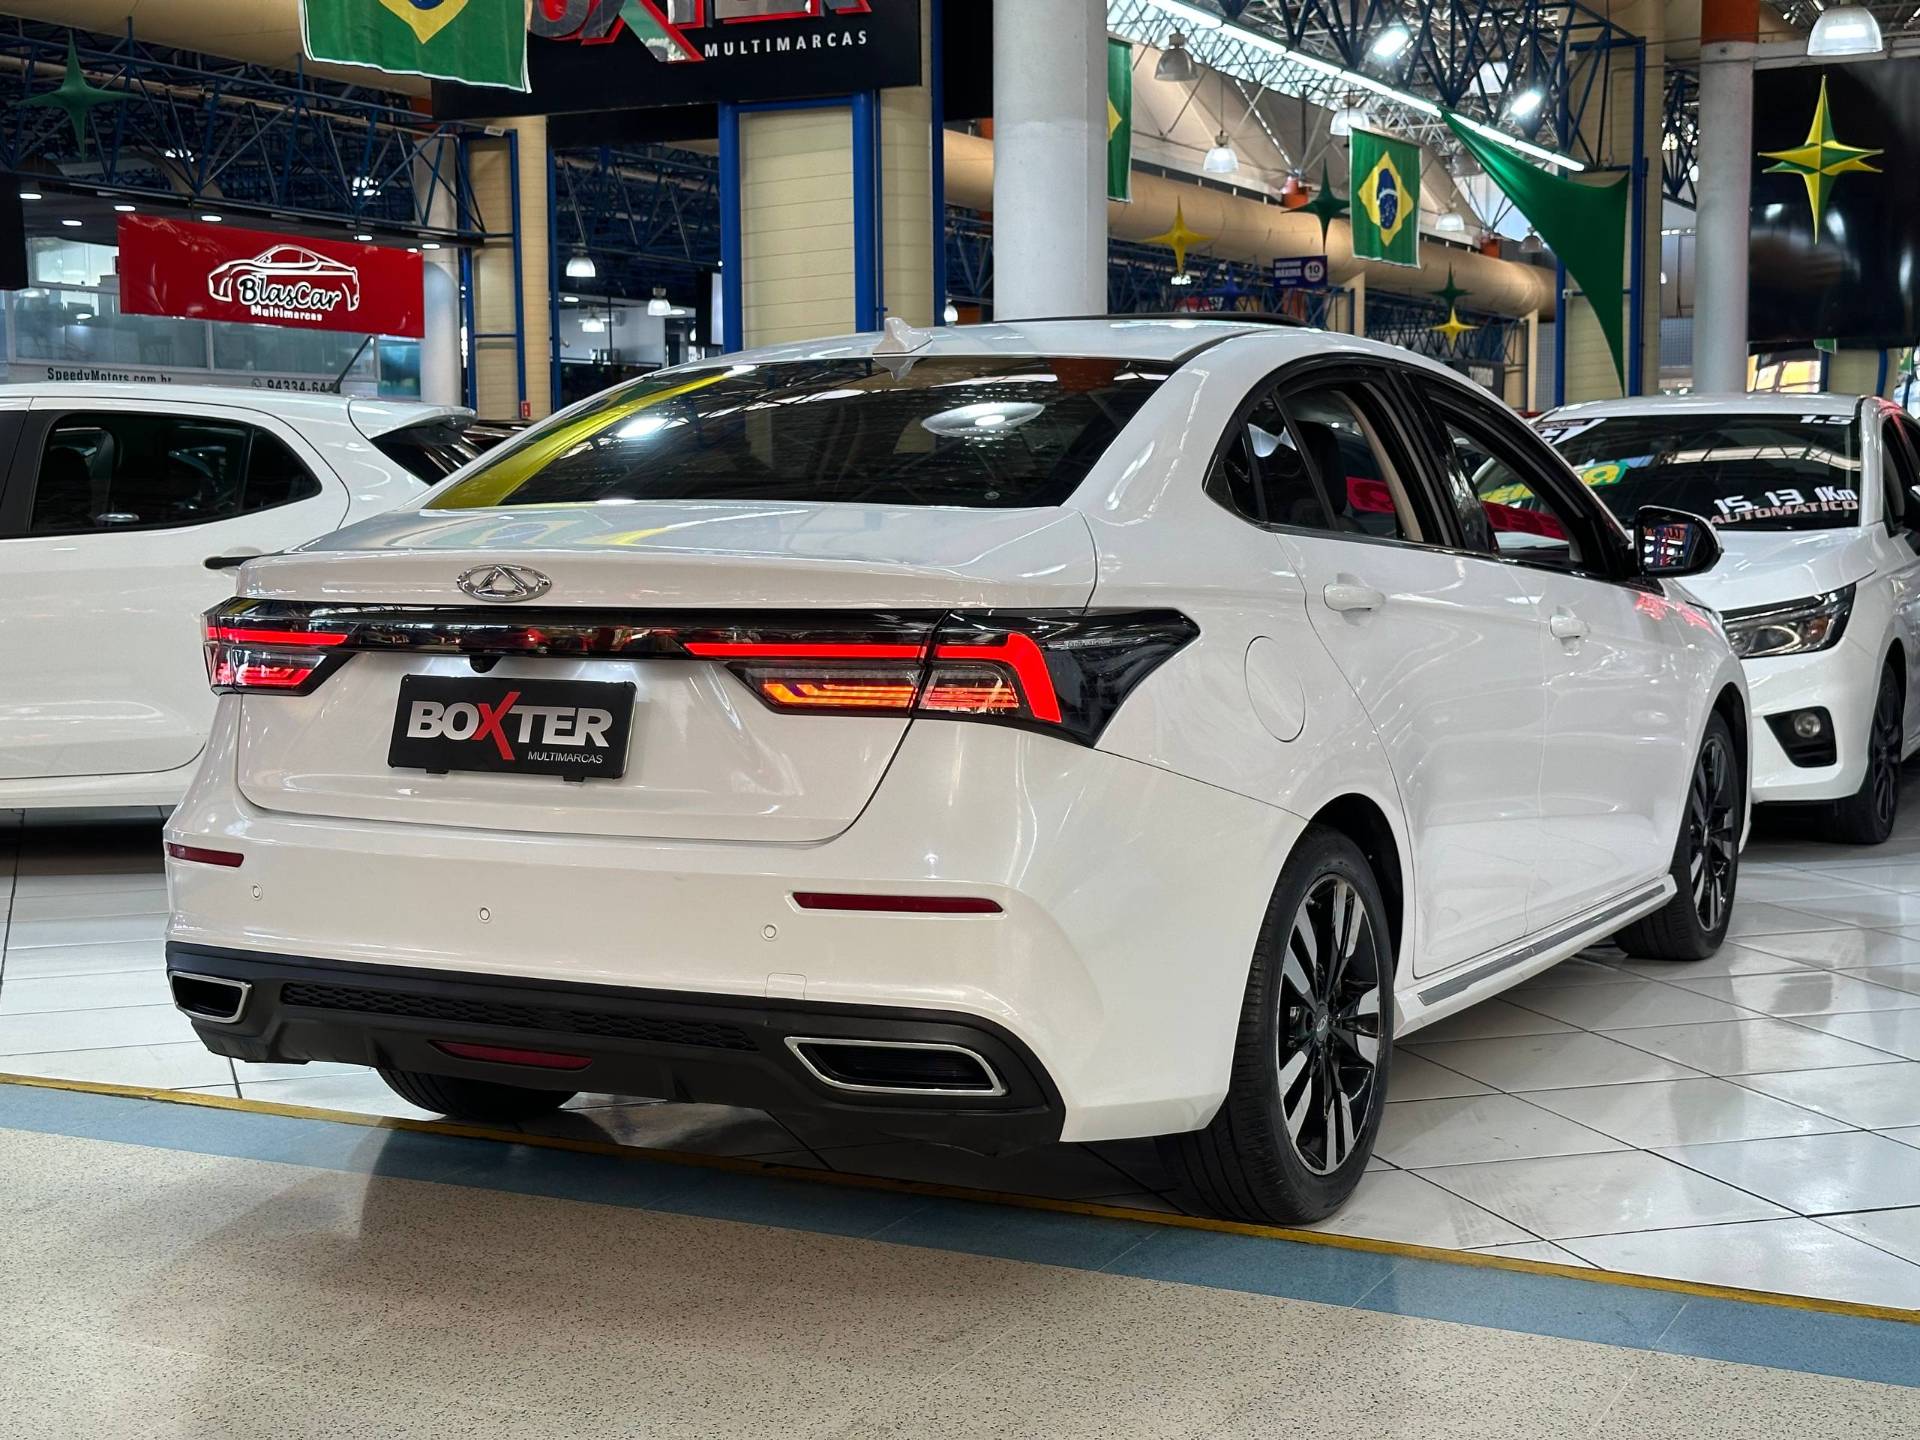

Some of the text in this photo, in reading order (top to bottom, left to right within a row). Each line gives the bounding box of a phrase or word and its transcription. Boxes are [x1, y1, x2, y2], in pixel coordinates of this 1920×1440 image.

[704, 30, 867, 58] MULTIMARCAS
[1308, 264, 1320, 274] 10
[238, 275, 342, 311] BlasCar
[251, 305, 323, 321] Multimarcas
[47, 367, 172, 383] SpeedyMotorscombr
[1711, 499, 1859, 525] AUTOMATICO
[406, 691, 613, 761] BOXTER
[527, 750, 604, 764] MULTIMARCAS
